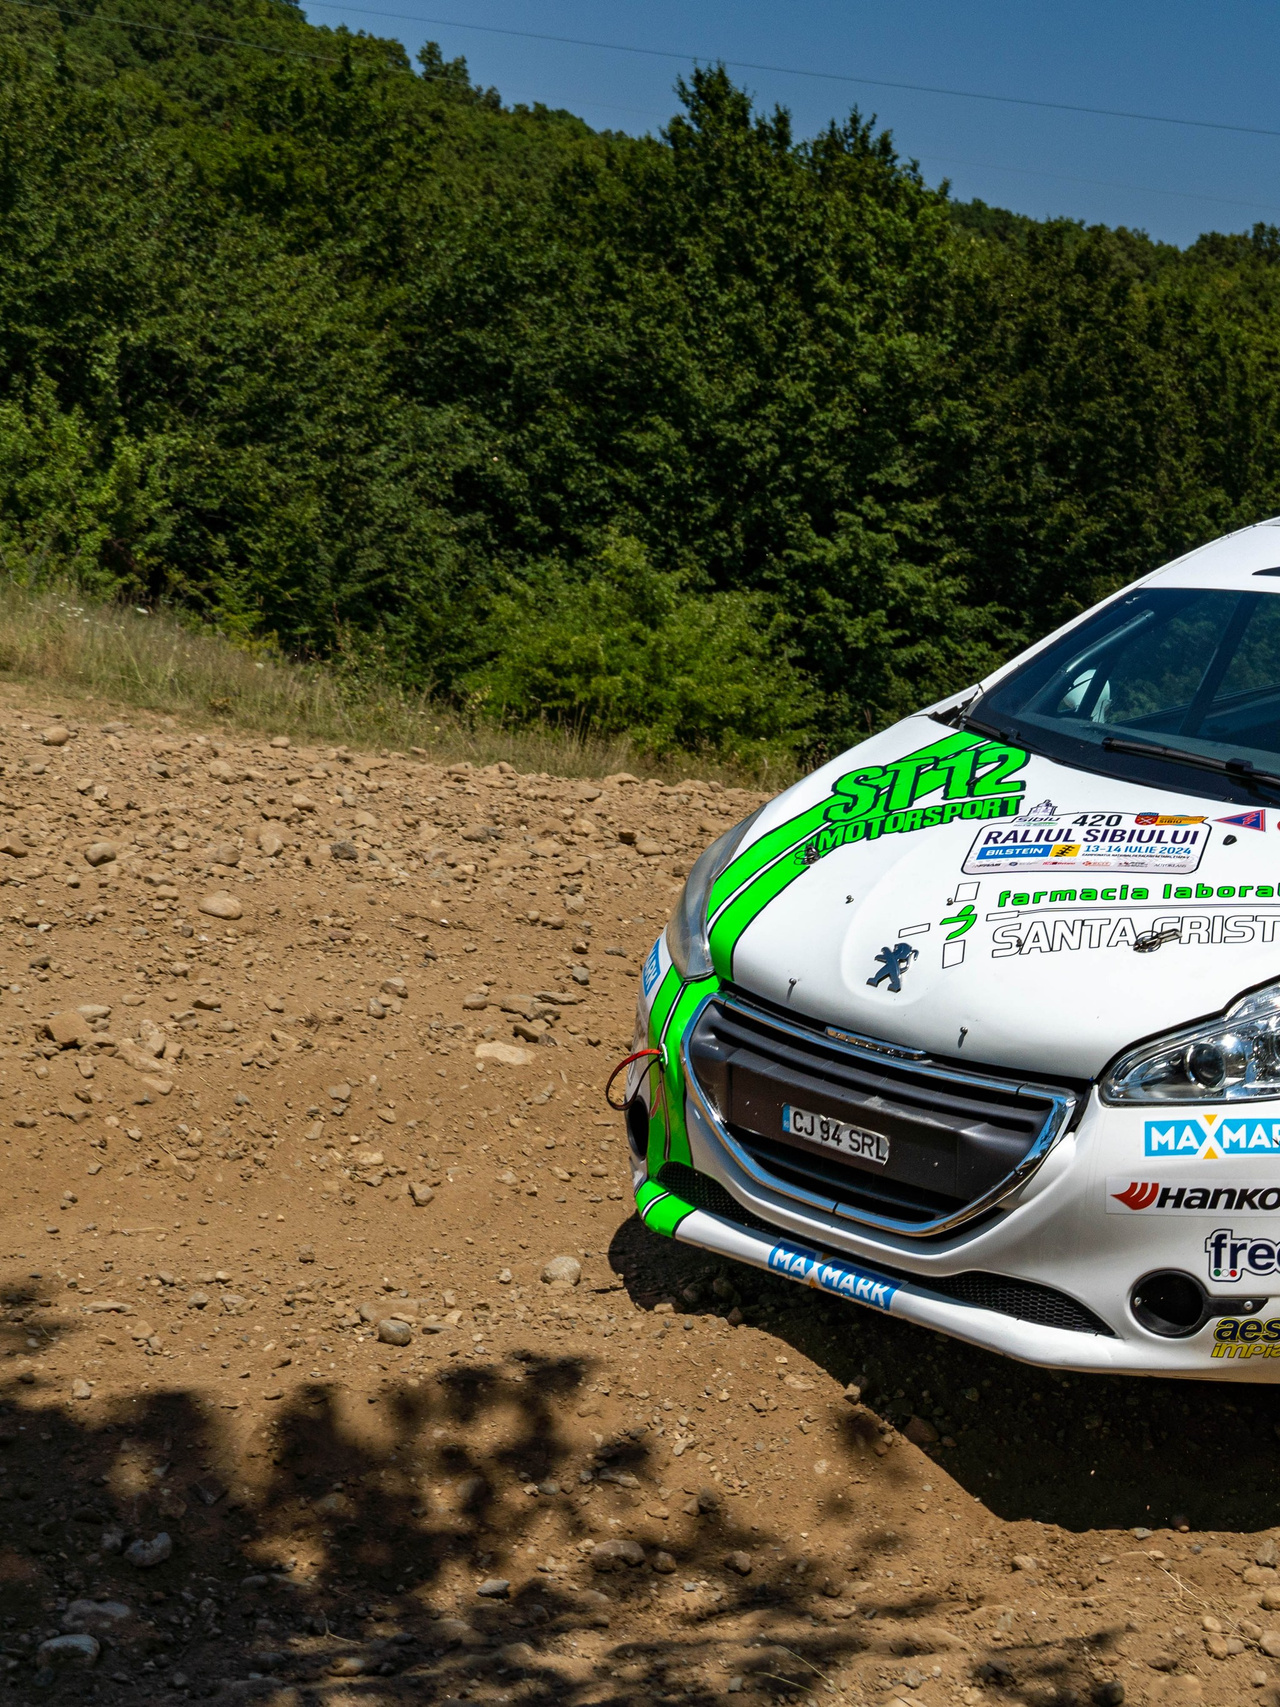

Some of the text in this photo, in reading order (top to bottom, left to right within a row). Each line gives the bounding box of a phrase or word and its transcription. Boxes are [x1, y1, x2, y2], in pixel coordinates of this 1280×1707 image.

[823, 747, 1031, 823] ST12
[815, 795, 1025, 853] MOTORSPORT
[983, 828, 1199, 846] RALIUL SIBIULUI
[1072, 815, 1123, 827] 420
[985, 847, 1045, 857] BILSTEIN
[1084, 845, 1191, 855] 13-14 IULIE 2024
[997, 884, 1150, 908] farmacia
[991, 917, 1141, 958] SANTA
[793, 1111, 886, 1161] CJ 94 SRL
[771, 1247, 892, 1308] MAXMARK
